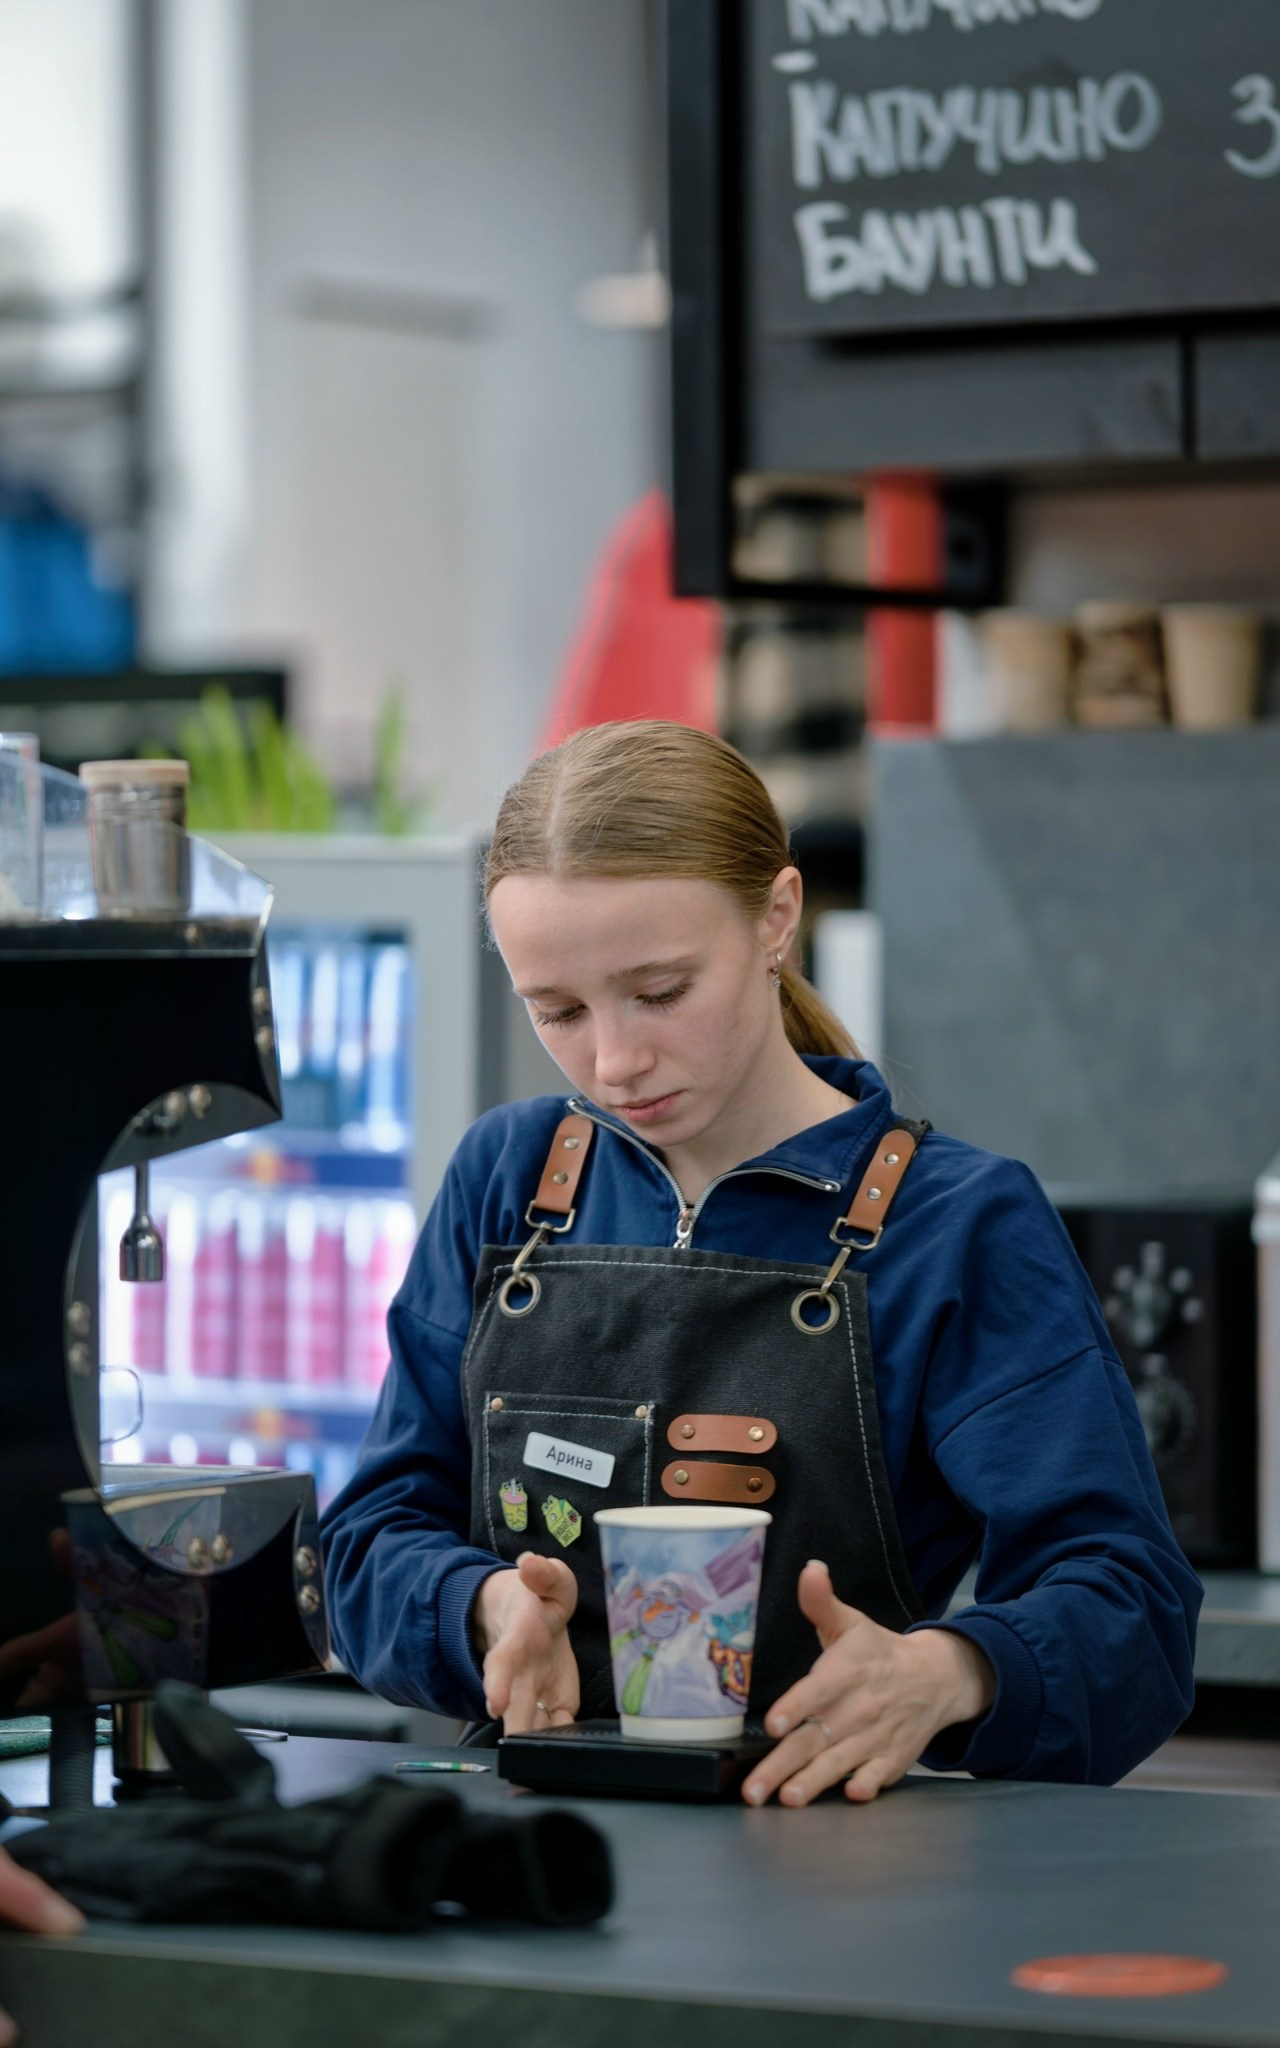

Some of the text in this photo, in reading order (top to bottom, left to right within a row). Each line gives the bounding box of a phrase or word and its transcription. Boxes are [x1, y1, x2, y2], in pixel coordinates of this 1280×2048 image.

[789, 71, 1162, 189] КАПУЧИНО
[794, 197, 1098, 301] БАУНТИ
[546, 1445, 593, 1471] Арина
